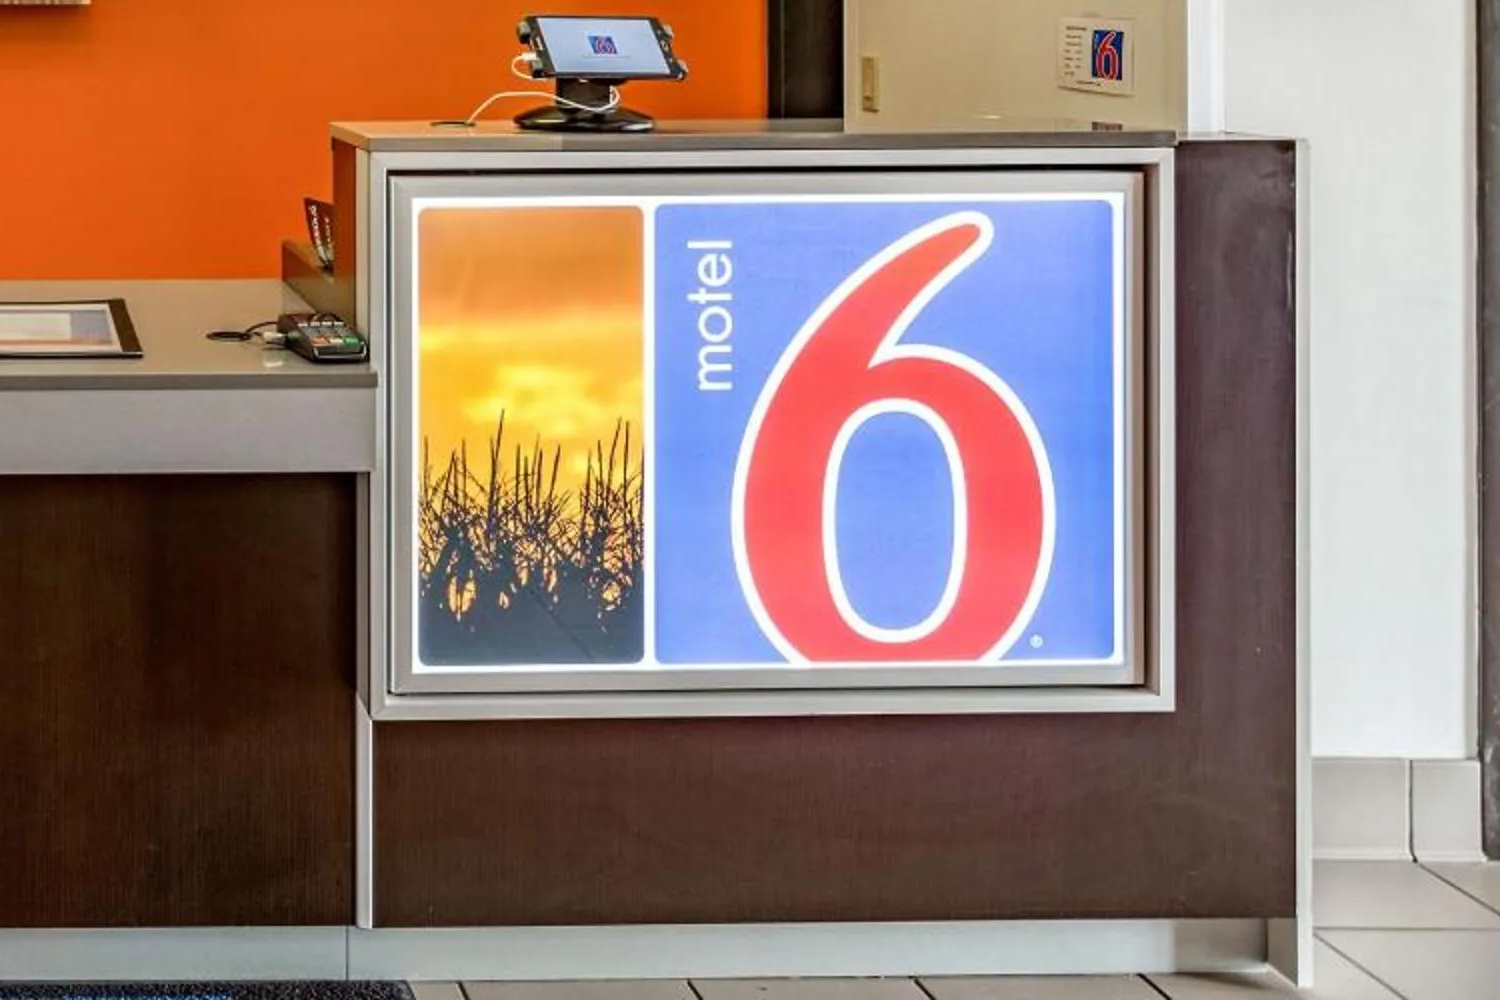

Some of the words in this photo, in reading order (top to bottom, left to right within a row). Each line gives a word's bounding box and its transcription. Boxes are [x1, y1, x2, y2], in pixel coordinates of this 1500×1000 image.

[1096, 31, 1119, 80] 6
[686, 239, 732, 391] motel
[730, 210, 1056, 664] 6
